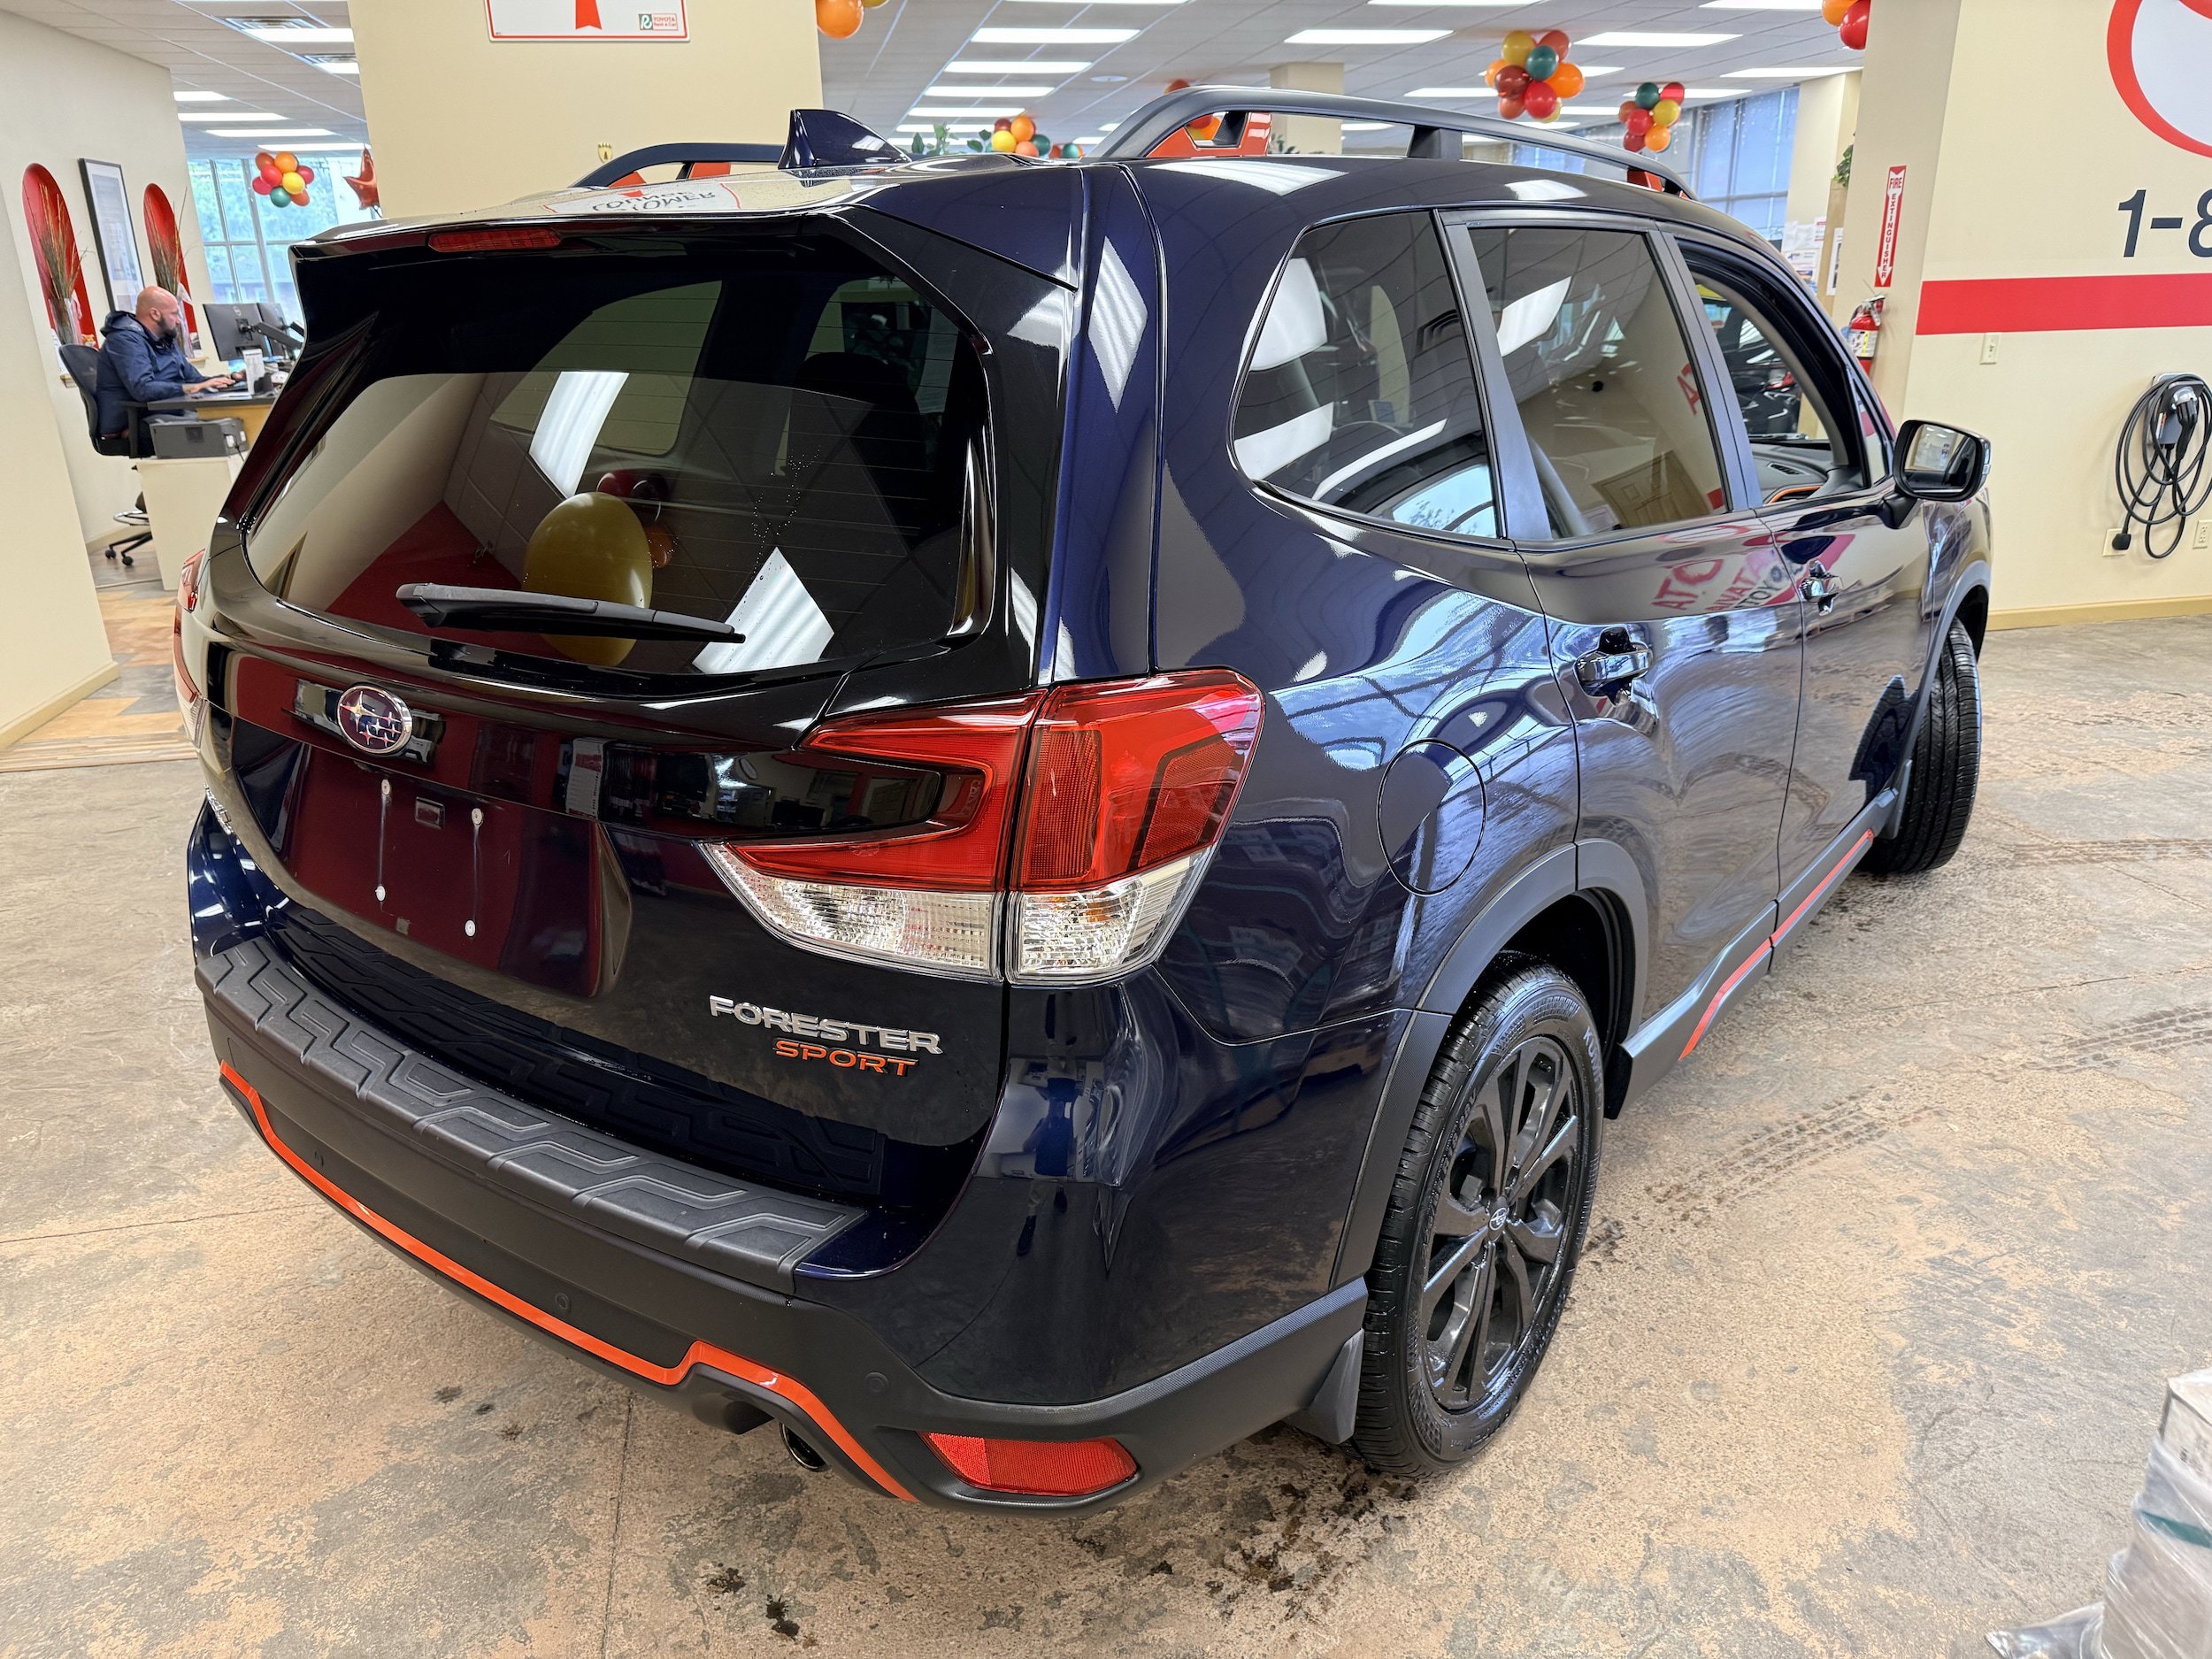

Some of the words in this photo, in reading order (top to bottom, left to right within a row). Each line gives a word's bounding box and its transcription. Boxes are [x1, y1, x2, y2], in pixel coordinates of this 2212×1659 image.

[1889, 177, 1902, 188] FIRE
[1881, 193, 1897, 279] EXTINGUISHER
[709, 995, 944, 1055] FORESTER
[774, 1038, 920, 1077] SPORT
